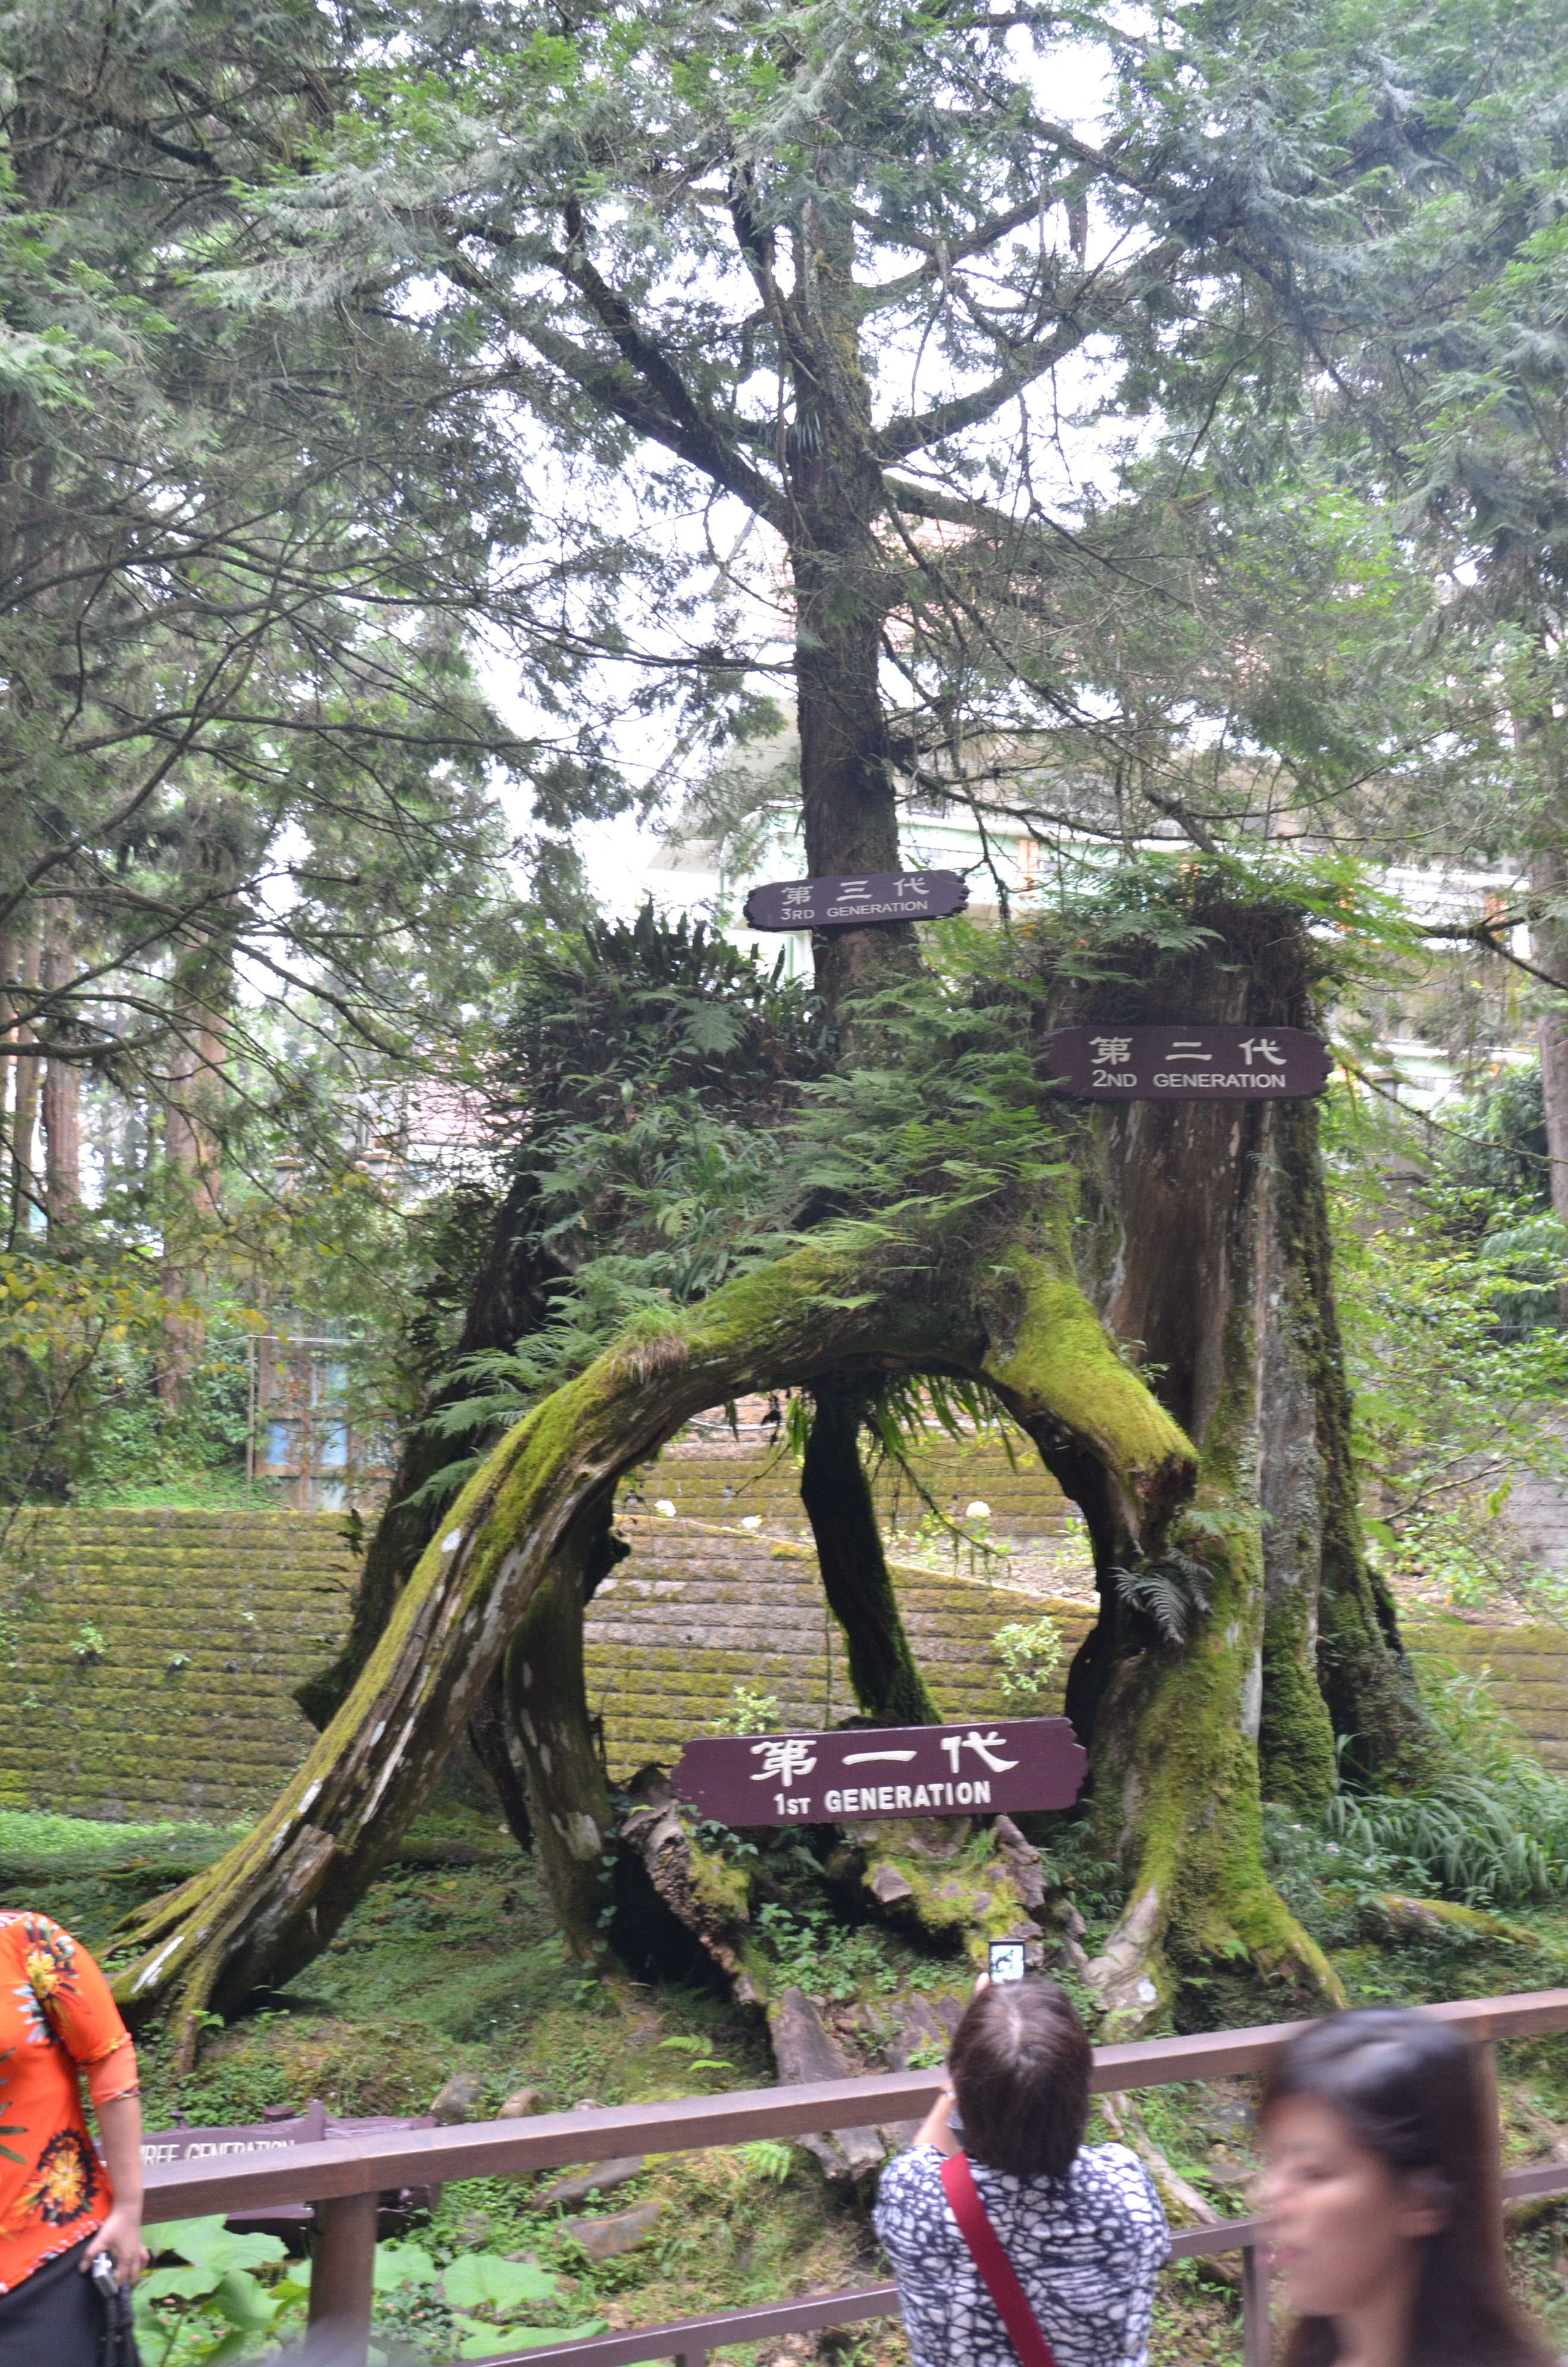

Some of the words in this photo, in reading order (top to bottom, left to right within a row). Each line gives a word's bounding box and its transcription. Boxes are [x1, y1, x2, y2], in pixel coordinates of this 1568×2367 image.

[780, 877, 929, 905] 第三代
[780, 908, 815, 920] 3RD
[826, 901, 928, 918] GENERATION
[1089, 1037, 1287, 1065] 第二代
[1091, 1069, 1137, 1087] 2ND
[1153, 1073, 1286, 1088] GENERATION
[749, 1731, 1019, 1787] 第一代
[824, 1781, 991, 1814] GENERATION
